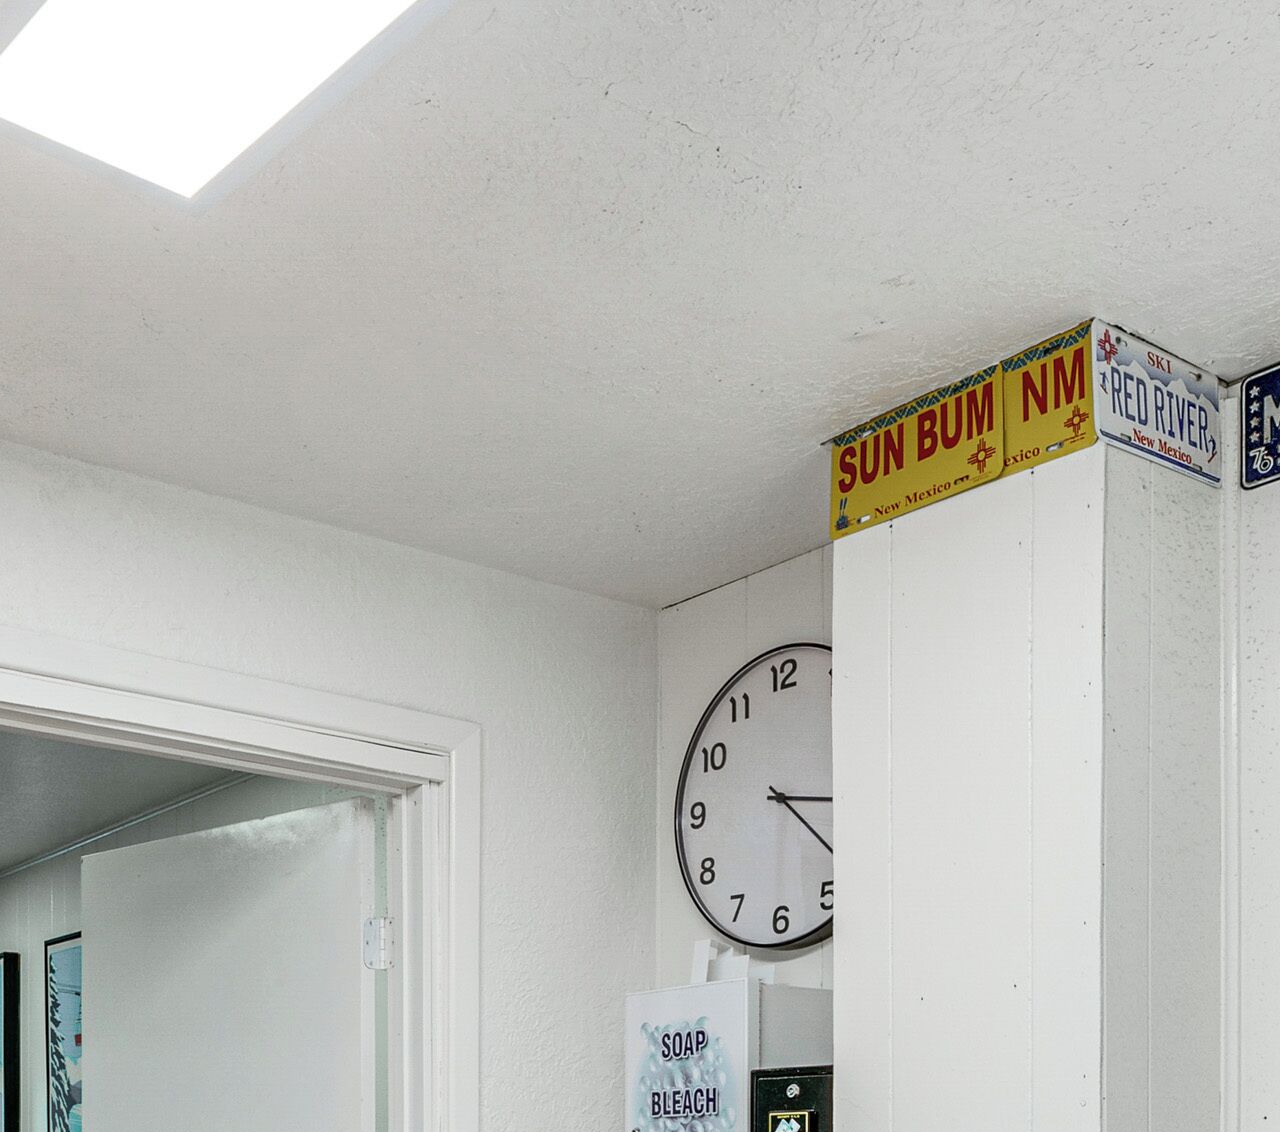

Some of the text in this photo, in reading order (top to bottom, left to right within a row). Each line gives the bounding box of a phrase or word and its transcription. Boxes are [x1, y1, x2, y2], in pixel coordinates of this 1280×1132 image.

[1147, 350, 1173, 375] SKI
[1021, 347, 1086, 423] NM
[1110, 365, 1211, 454] RED RIVER
[838, 381, 994, 494] SUN BUM
[1132, 428, 1193, 465] New Mexico
[1004, 446, 1041, 468] exico
[874, 481, 952, 519] New Mexico
[770, 657, 798, 693] 12
[728, 692, 750, 723] 11
[701, 742, 727, 774] 10
[689, 801, 707, 830] 9
[699, 857, 716, 886] 8
[730, 893, 745, 923] 7
[820, 880, 833, 911] 5
[772, 905, 790, 935] 6
[660, 1028, 708, 1061] SOAP
[650, 1086, 720, 1118] BLEACH
